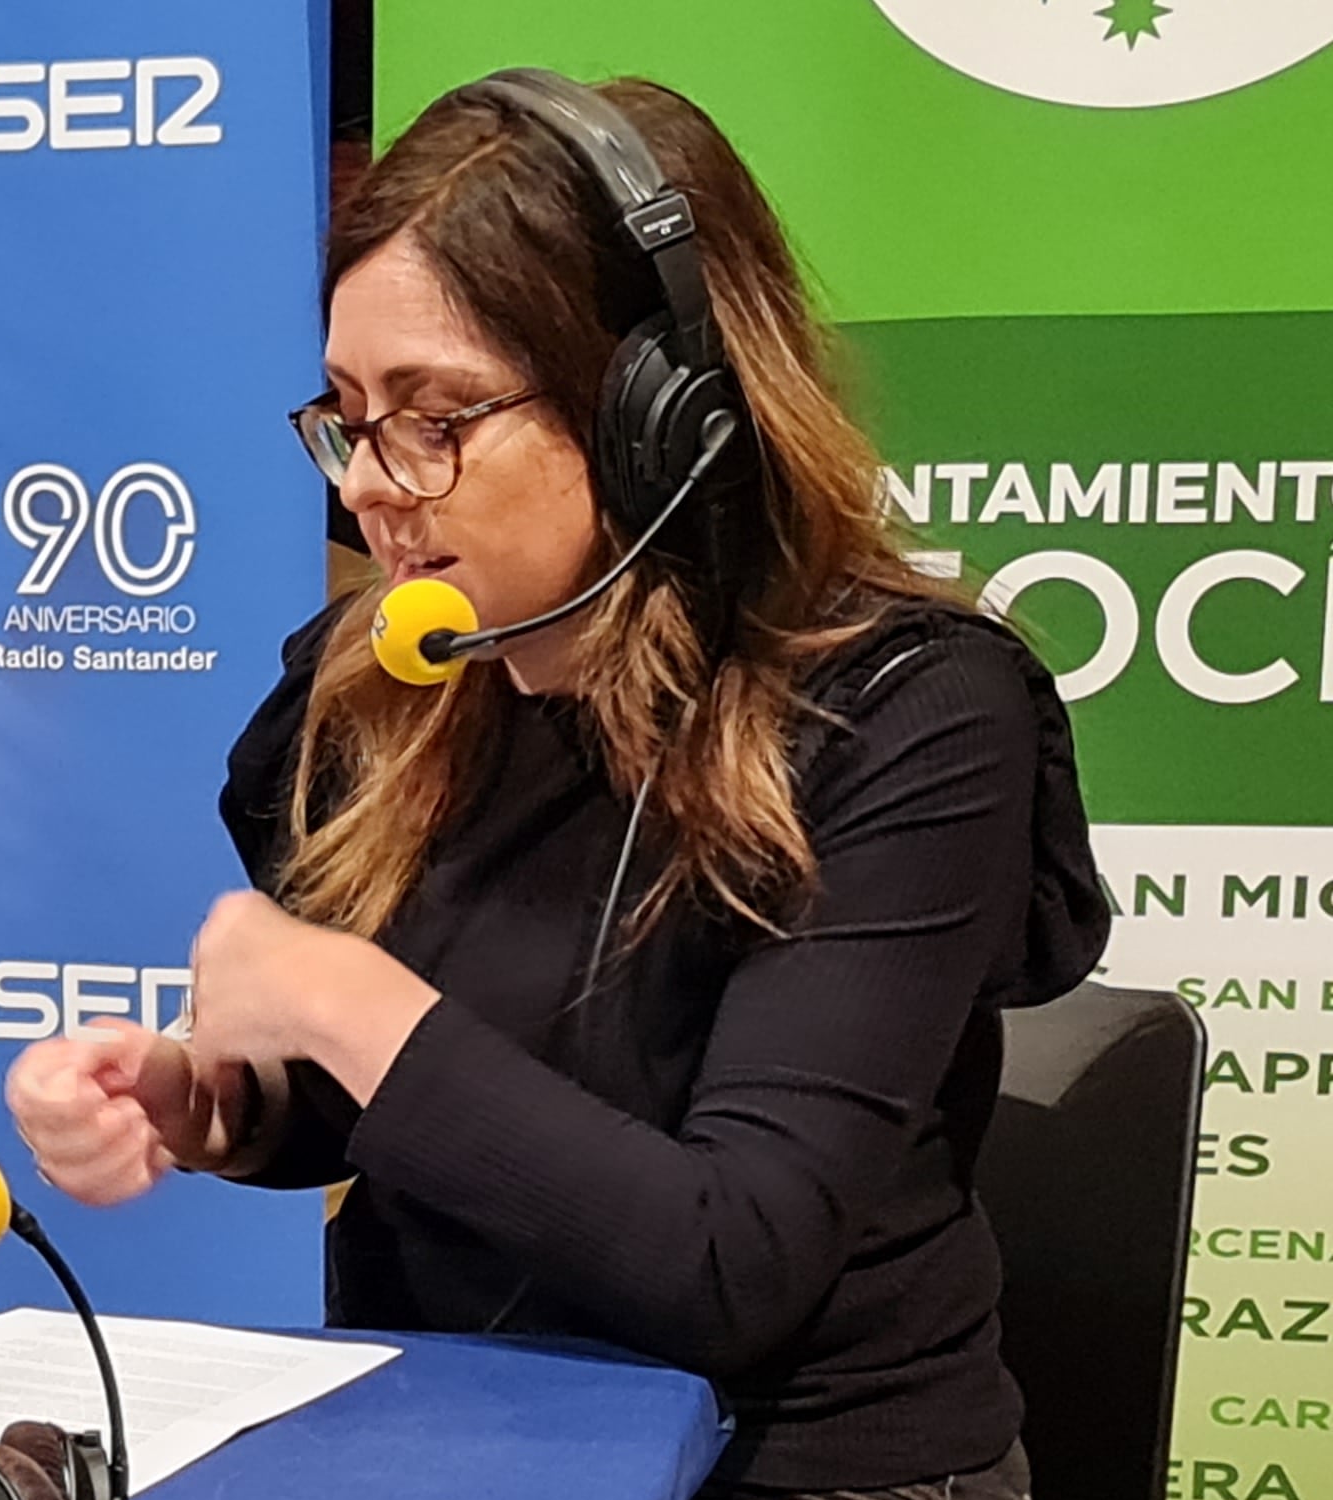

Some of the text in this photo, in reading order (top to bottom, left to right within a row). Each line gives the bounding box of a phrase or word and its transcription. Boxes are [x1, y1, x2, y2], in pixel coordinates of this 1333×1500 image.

[877, 461, 1333, 524] NTAMIENT
[3, 463, 196, 595] 90
[3, 604, 196, 634] ANIVERSARIO
[72, 645, 218, 671] Santander
[1177, 977, 1297, 1011] SAN
[1203, 1050, 1333, 1096] AP
[1195, 1133, 1271, 1178] ES
[1182, 1296, 1331, 1343] RAZ
